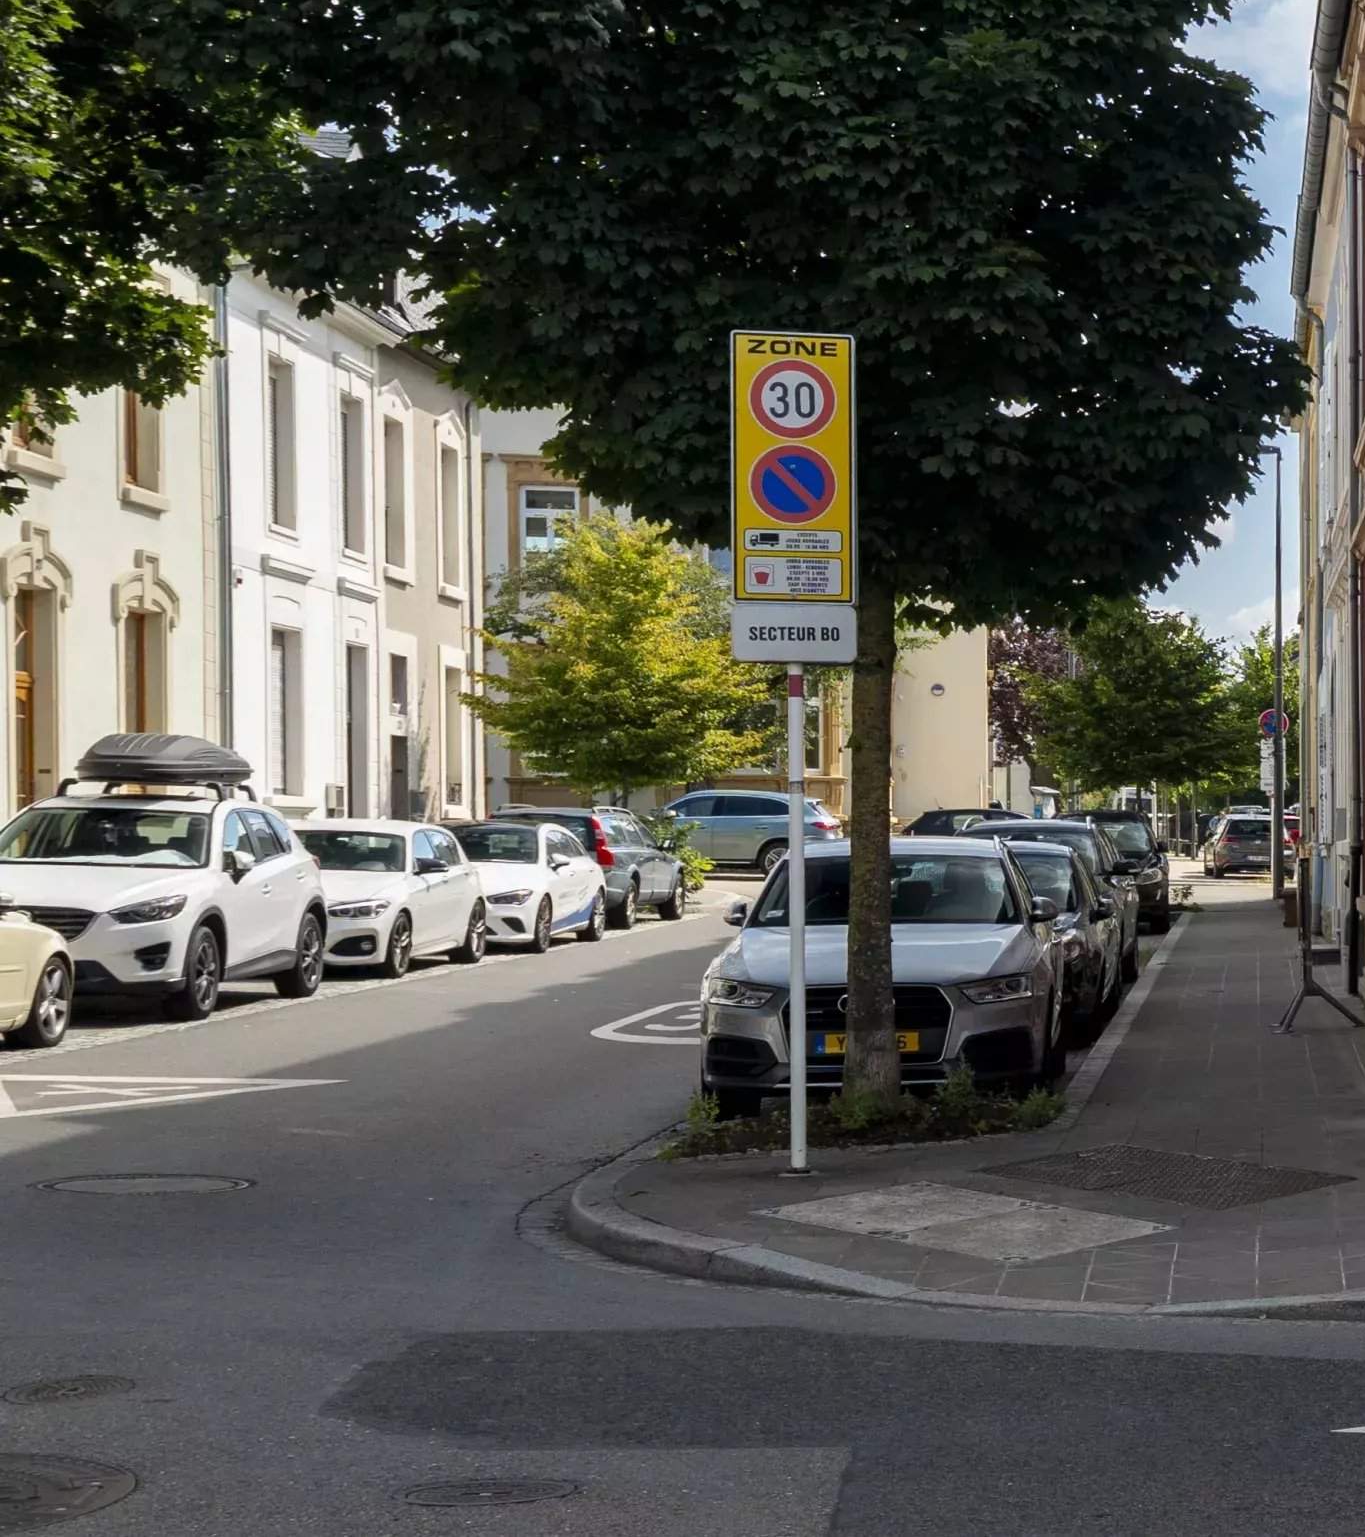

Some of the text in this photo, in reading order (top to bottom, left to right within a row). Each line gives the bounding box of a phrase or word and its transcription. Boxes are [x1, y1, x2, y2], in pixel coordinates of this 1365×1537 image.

[747, 339, 837, 357] ZONE
[769, 381, 815, 419] 30
[749, 626, 816, 641] SECTEUR
